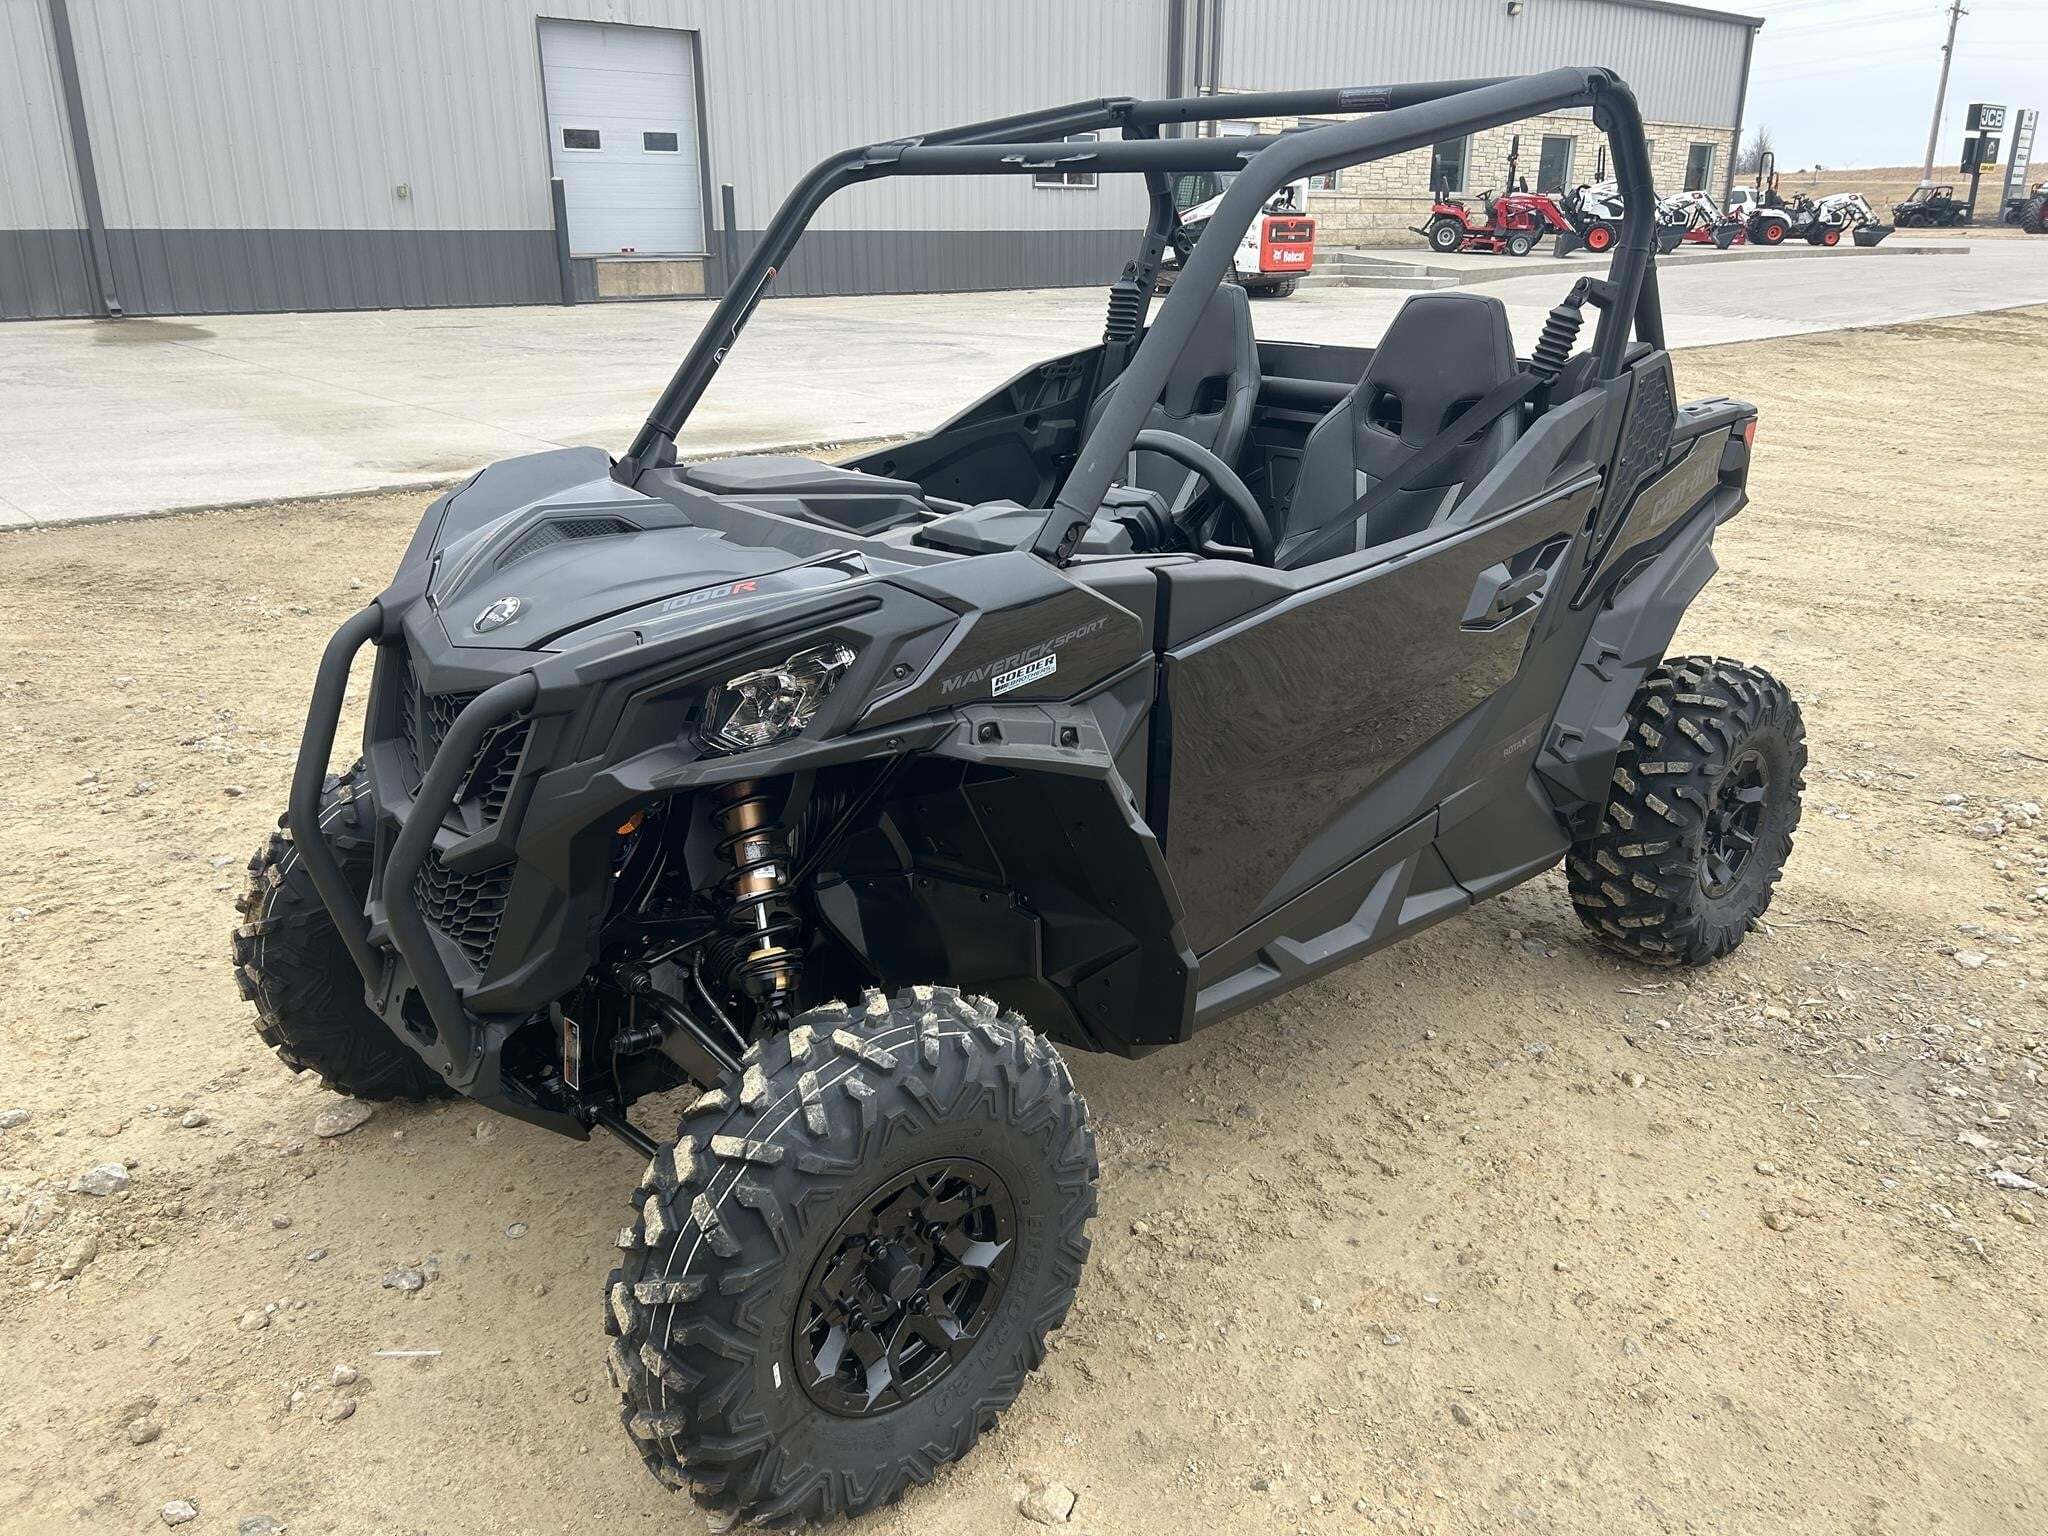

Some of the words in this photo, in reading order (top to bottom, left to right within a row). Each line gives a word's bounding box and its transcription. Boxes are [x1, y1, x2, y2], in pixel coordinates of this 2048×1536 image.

[1981, 108, 2004, 127] JCB
[1283, 249, 1305, 263] Bobcat
[661, 580, 758, 612] 1000R
[941, 642, 1054, 695] MAVERICK
[1053, 617, 1108, 648] SPORT
[995, 656, 1055, 686] ROEDER
[1503, 737, 1528, 758] ROTAX
